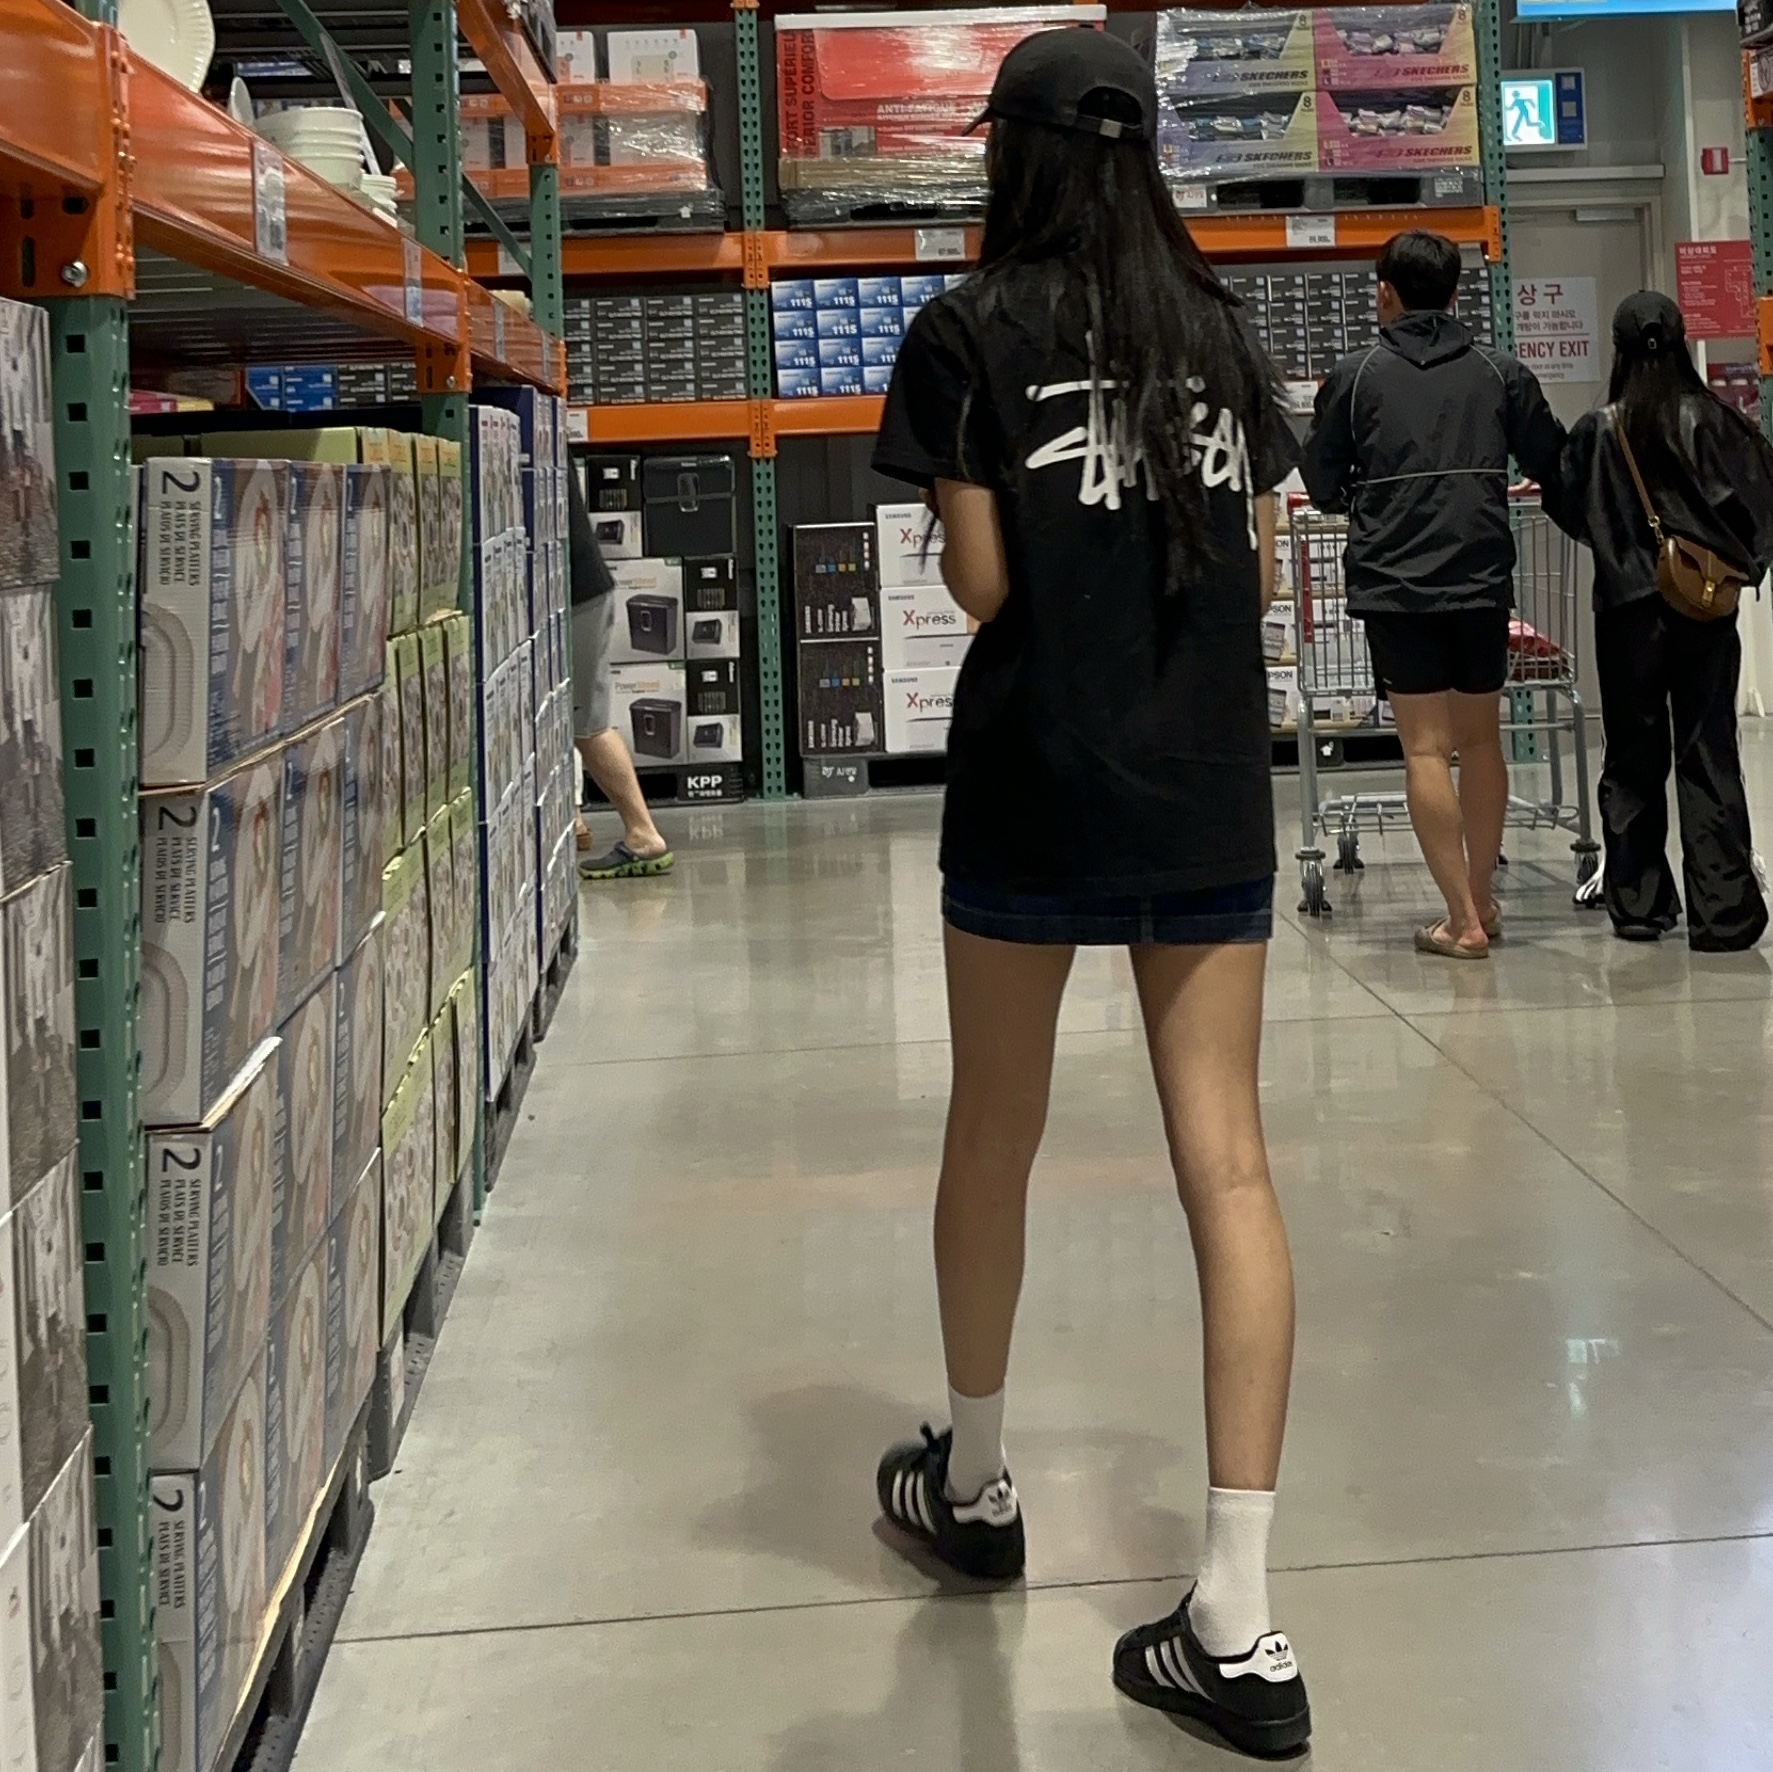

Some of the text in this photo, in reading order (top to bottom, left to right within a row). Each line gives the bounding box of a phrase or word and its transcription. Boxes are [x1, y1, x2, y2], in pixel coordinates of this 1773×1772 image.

[1240, 70, 1309, 82] SKECHERS
[1402, 64, 1469, 76] SKECHERS
[1304, 96, 1312, 108] 8
[1462, 90, 1471, 102] 8
[1244, 151, 1312, 162] SKECHERS
[1404, 145, 1472, 157] SKECHERS
[1560, 340, 1590, 357] EXIT
[162, 470, 201, 494] 2
[903, 610, 956, 629] Xpress
[688, 775, 722, 789] KPP
[158, 806, 198, 830] 2
[162, 1148, 202, 1172] 2
